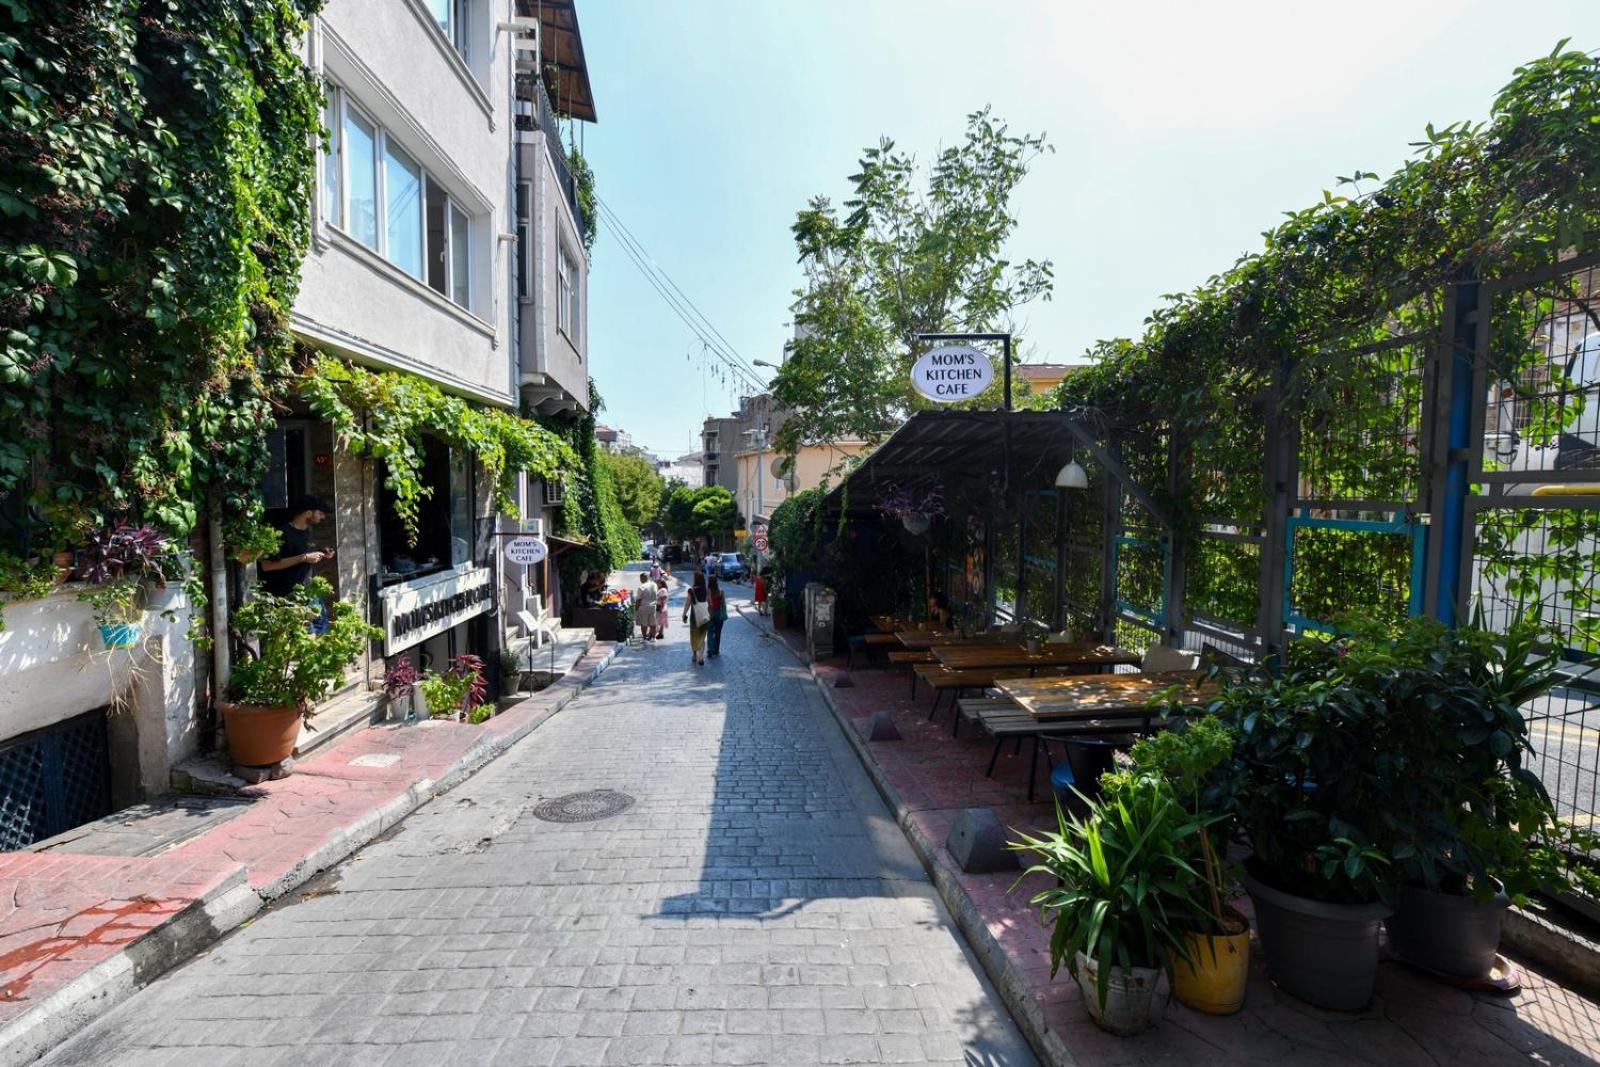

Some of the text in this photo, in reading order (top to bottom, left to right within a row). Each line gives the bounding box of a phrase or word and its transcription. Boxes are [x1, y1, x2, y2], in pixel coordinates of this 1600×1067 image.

[931, 353, 975, 366] MOM'S
[926, 368, 982, 381] KITCHEN
[936, 383, 968, 395] CAFE
